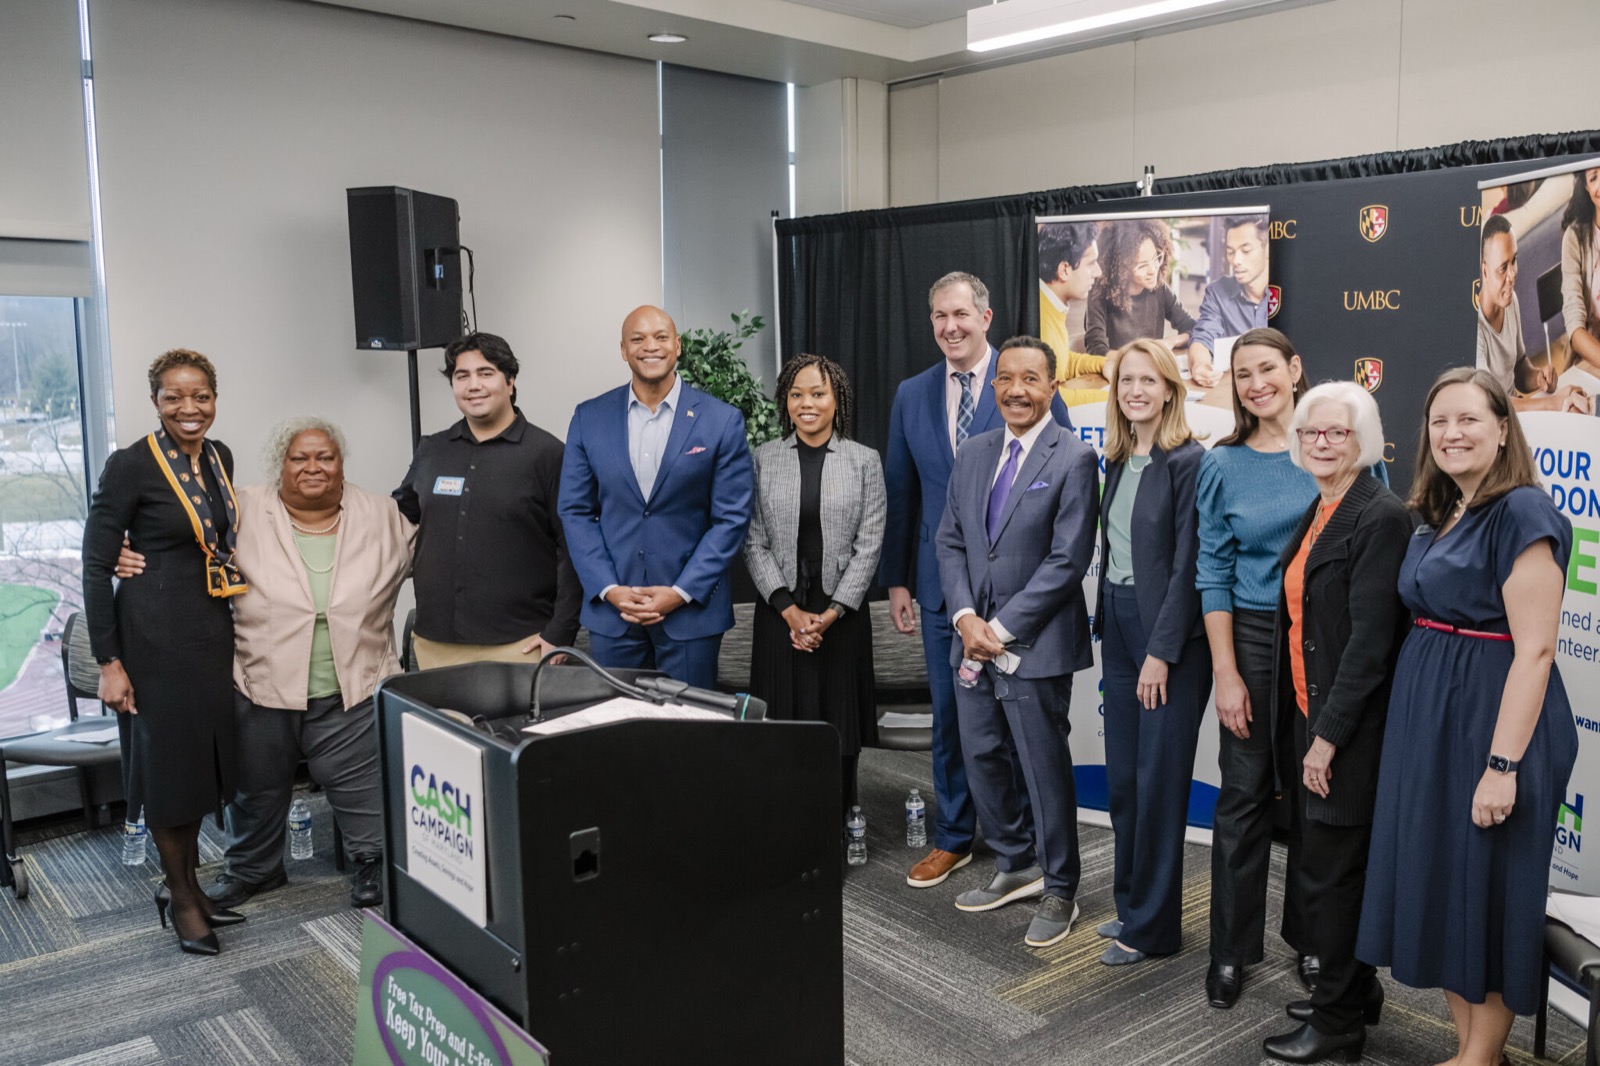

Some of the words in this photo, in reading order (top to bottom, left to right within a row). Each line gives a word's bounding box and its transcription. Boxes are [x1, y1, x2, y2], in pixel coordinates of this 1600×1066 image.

[1268, 219, 1297, 240] BC
[1343, 290, 1400, 310] UMBC
[1072, 427, 1105, 448] ET
[411, 764, 472, 837] CASH
[411, 806, 473, 860] CAMPAIGN
[386, 998, 417, 1050] Keep
[387, 975, 407, 1006] Free
[408, 991, 424, 1021] Tax
[425, 1006, 447, 1042] Prep
[447, 1031, 467, 1058] and
